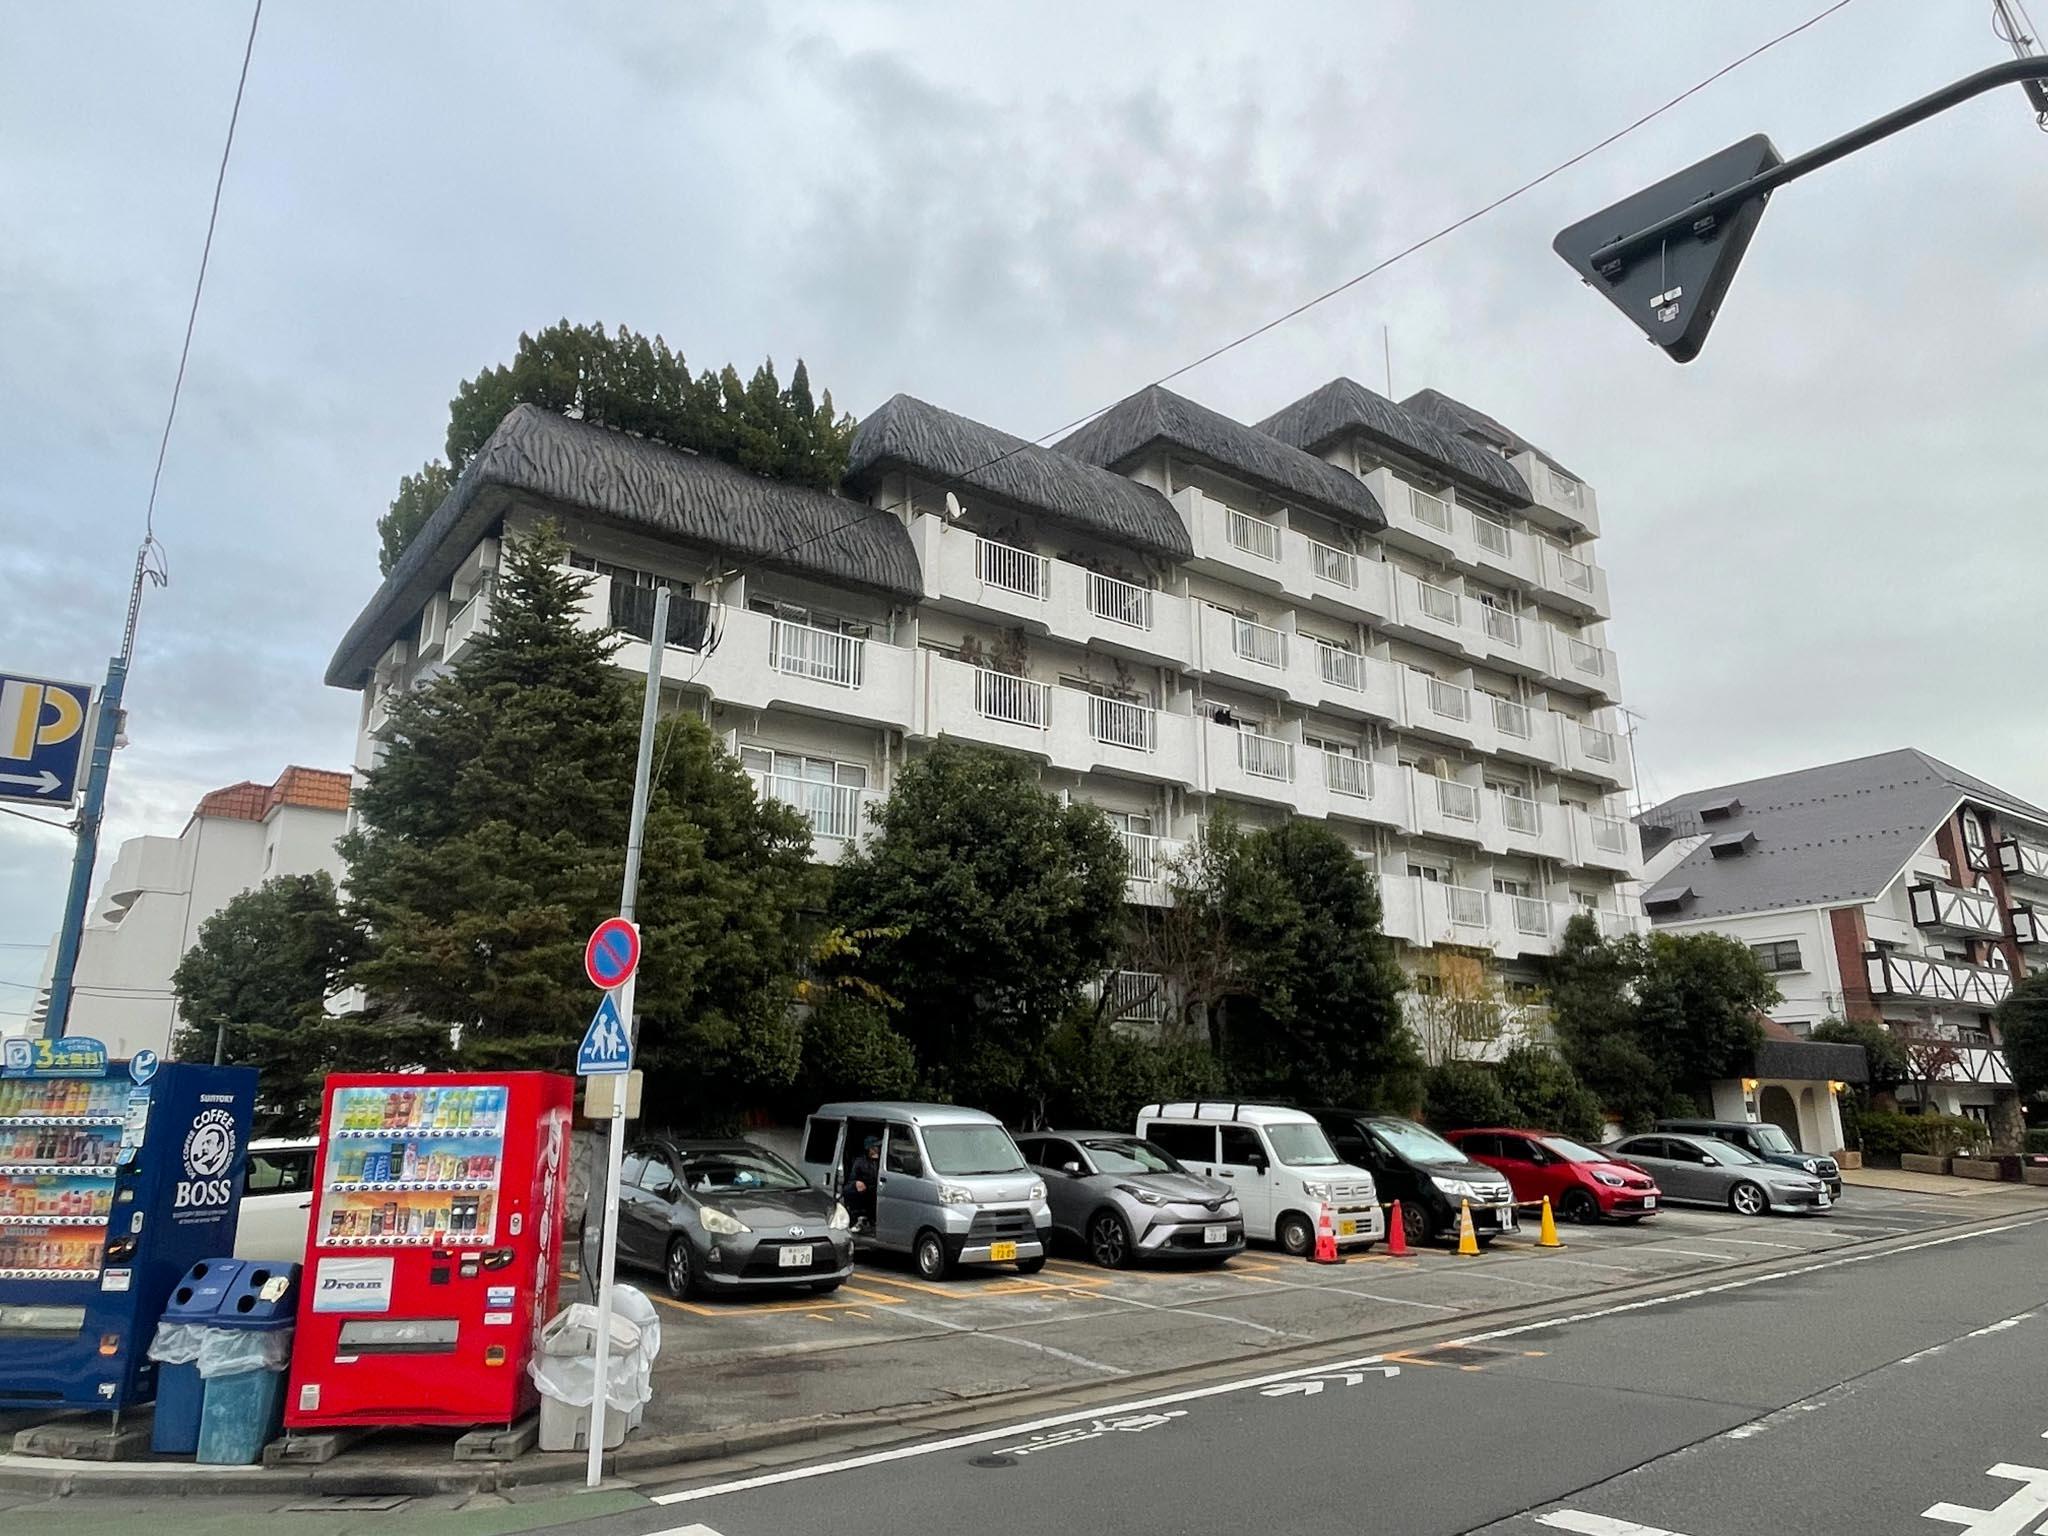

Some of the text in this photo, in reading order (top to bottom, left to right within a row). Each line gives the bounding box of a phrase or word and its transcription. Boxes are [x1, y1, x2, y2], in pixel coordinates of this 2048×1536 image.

[0, 680, 84, 761] P
[134, 1053, 155, 1075] ピ
[200, 1094, 234, 1103] SUNTORY
[193, 1108, 235, 1130] COFFEE
[174, 1179, 232, 1207] BOSS
[322, 1279, 382, 1290] Dream
